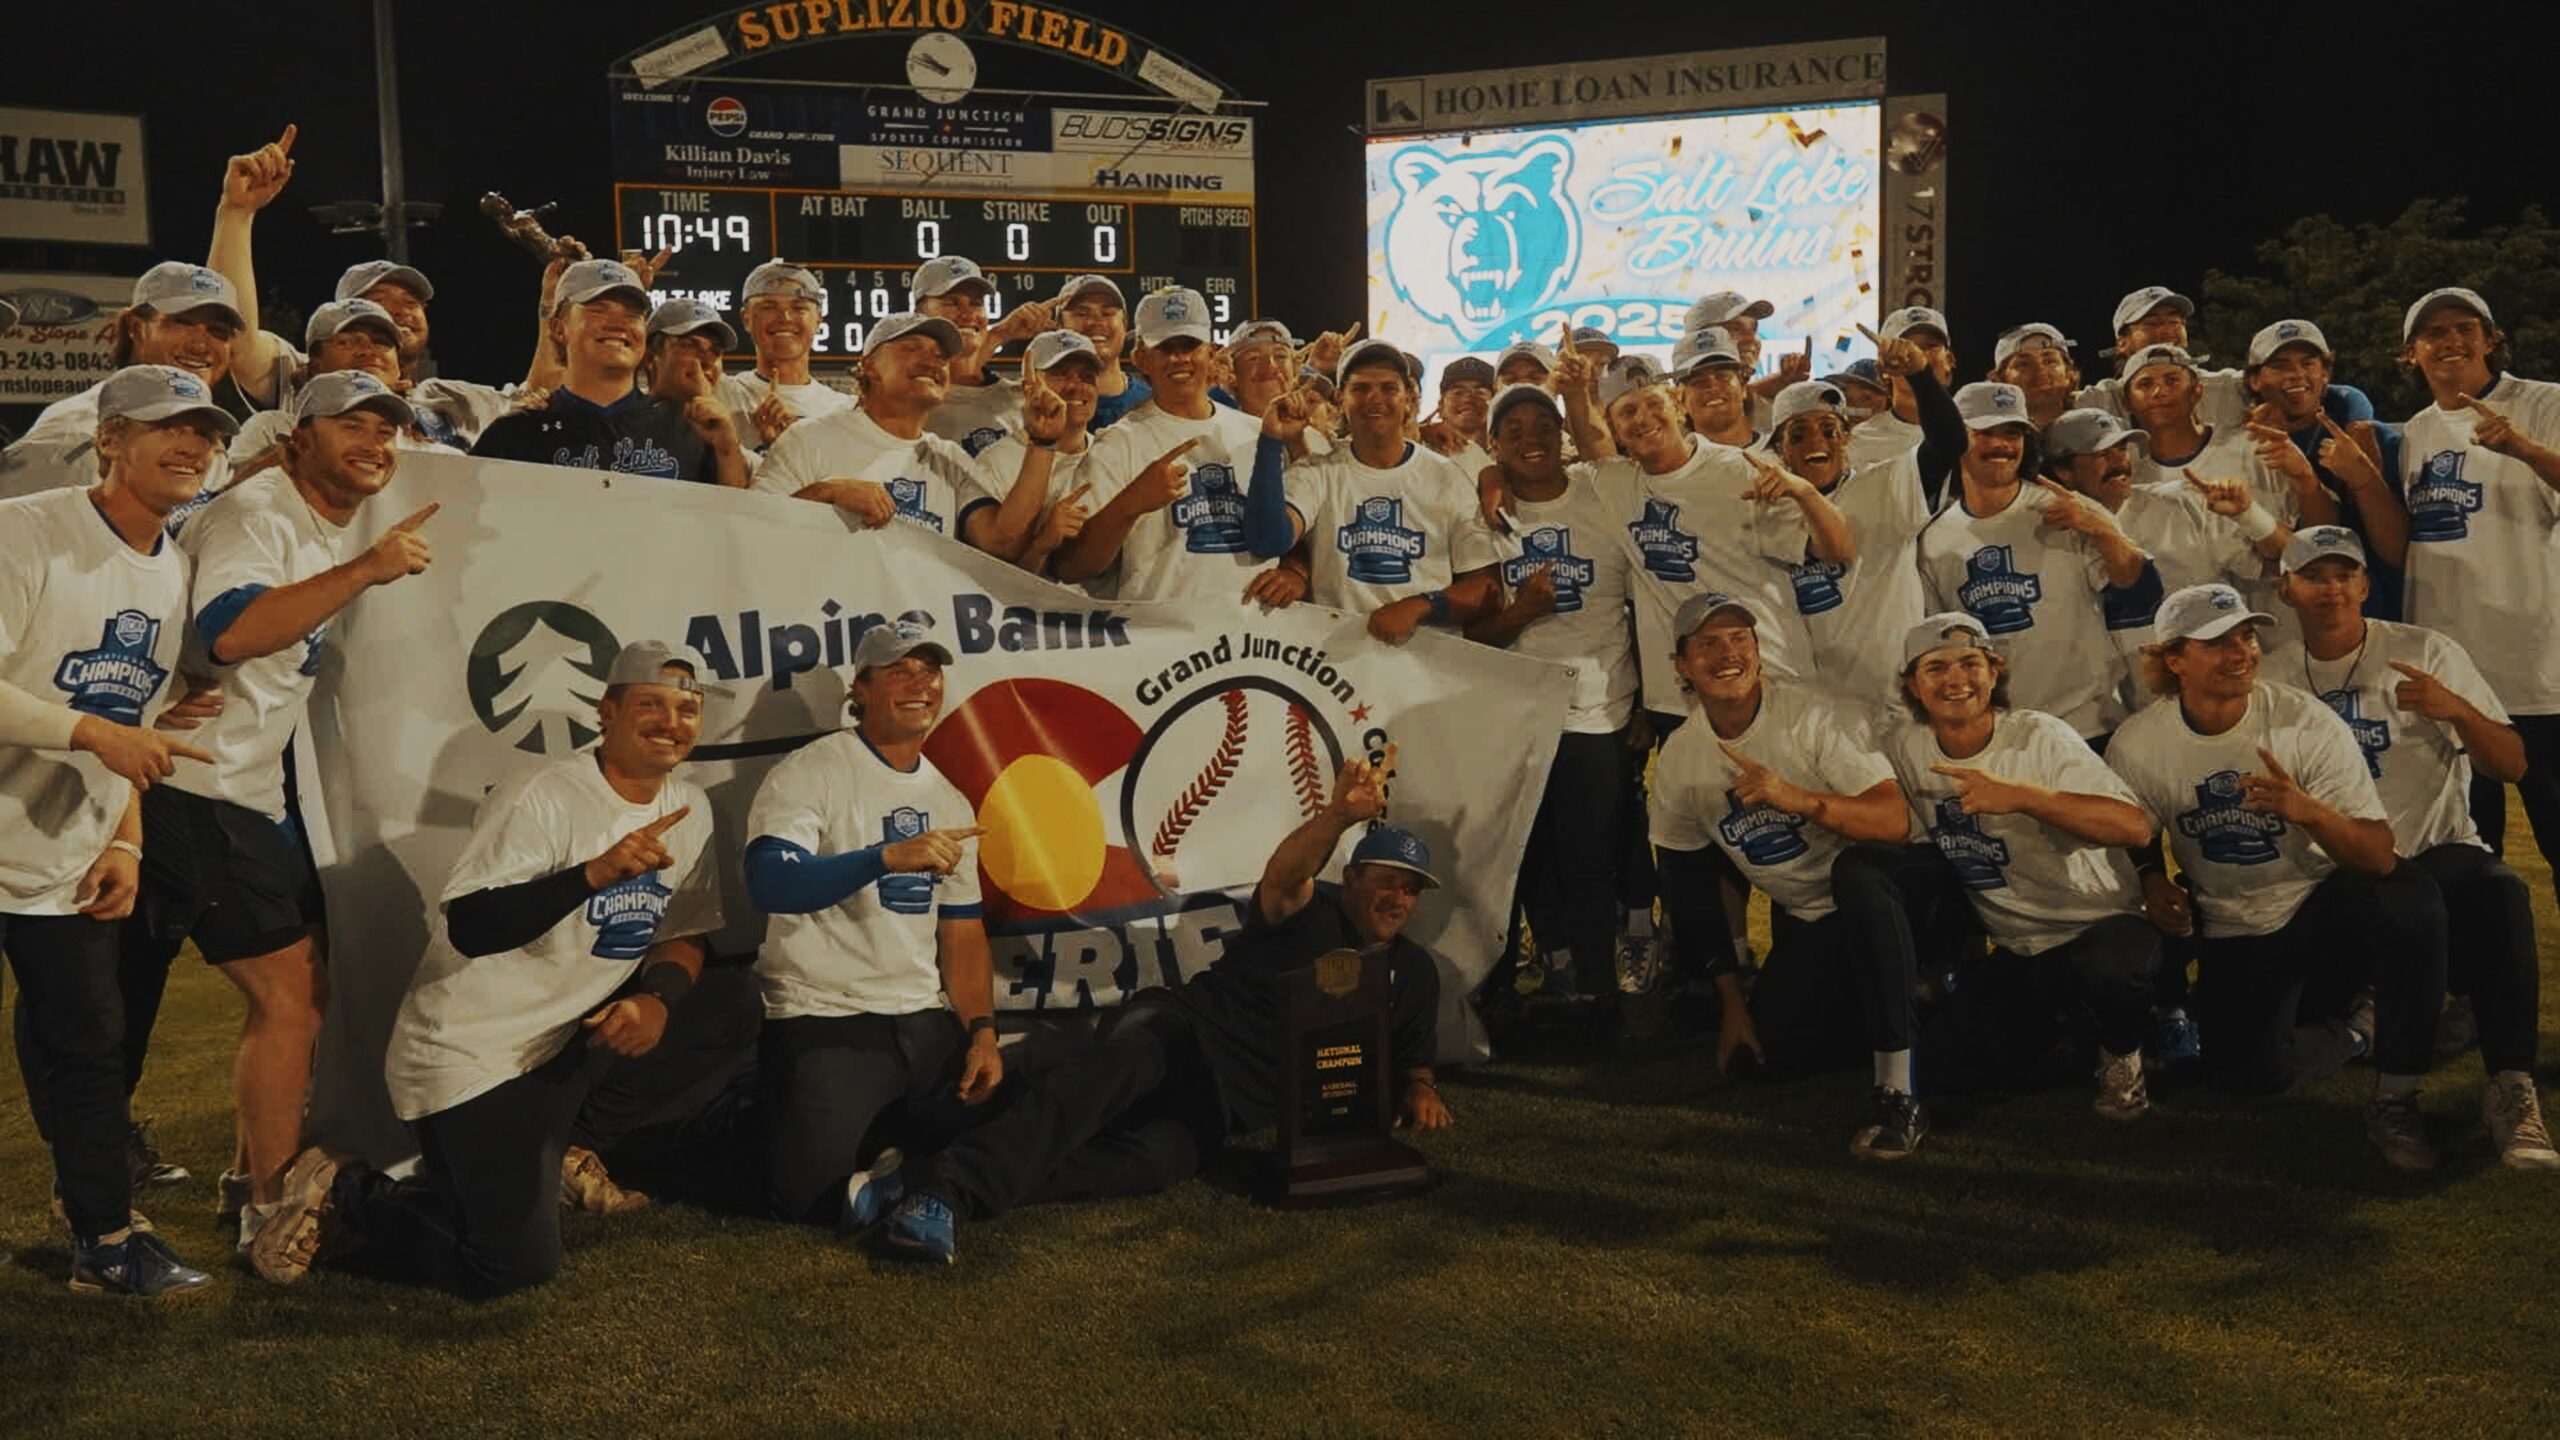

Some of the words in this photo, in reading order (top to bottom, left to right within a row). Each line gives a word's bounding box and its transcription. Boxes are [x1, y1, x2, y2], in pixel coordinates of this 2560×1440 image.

[738, 0, 967, 49] SUPLIZIO
[987, 0, 1128, 66] FIELD
[1434, 83, 1537, 114] HOME
[1552, 73, 1651, 105] LOAN
[1666, 51, 1885, 96] INSURANCE
[709, 111, 745, 123] PEPSI
[867, 105, 926, 119] GRAND
[937, 109, 1024, 123] JUNCTION
[749, 131, 783, 140] GRAND
[871, 133, 924, 143] SPORTS
[932, 135, 1023, 147] COMMISSION
[665, 145, 733, 164] Killian
[737, 147, 791, 165] Davis
[880, 150, 1013, 178] SEQUENT
[687, 165, 735, 182] Injury
[739, 166, 771, 181] Law
[1096, 169, 1223, 190] HAINING
[1589, 152, 1735, 222] Salt
[1746, 146, 1871, 212] Lake
[660, 191, 711, 213] TIME
[801, 196, 825, 216] AT
[830, 197, 869, 217] BAT
[902, 199, 951, 220] BALL
[983, 202, 1050, 222] STRIKE
[1087, 204, 1124, 224] OUT
[1180, 207, 1214, 226] PITCH
[1216, 209, 1250, 228] SPEED
[643, 214, 750, 253] 10:49
[917, 221, 940, 259] 0
[1007, 223, 1029, 261] 0
[1094, 226, 1116, 263] 0
[1629, 214, 1833, 276] Bruins
[846, 270, 857, 288] 4
[874, 271, 885, 287] 5
[901, 271, 912, 288] 6
[1013, 274, 1035, 291] 10
[1140, 276, 1175, 292] HITS
[1205, 277, 1236, 294] ERR
[870, 288, 889, 318] 0
[1214, 294, 1230, 323] 3
[1530, 301, 1686, 349] 2025
[811, 322, 830, 352] 2
[844, 322, 864, 352] 0
[610, 436, 679, 475] Lake
[952, 593, 1131, 655] Bank
[1135, 634, 1232, 706] Grand
[1240, 632, 1356, 704] Junction
[1316, 1044, 1362, 1058] NATIONAL
[1316, 1056, 1362, 1070] CHAMPION
